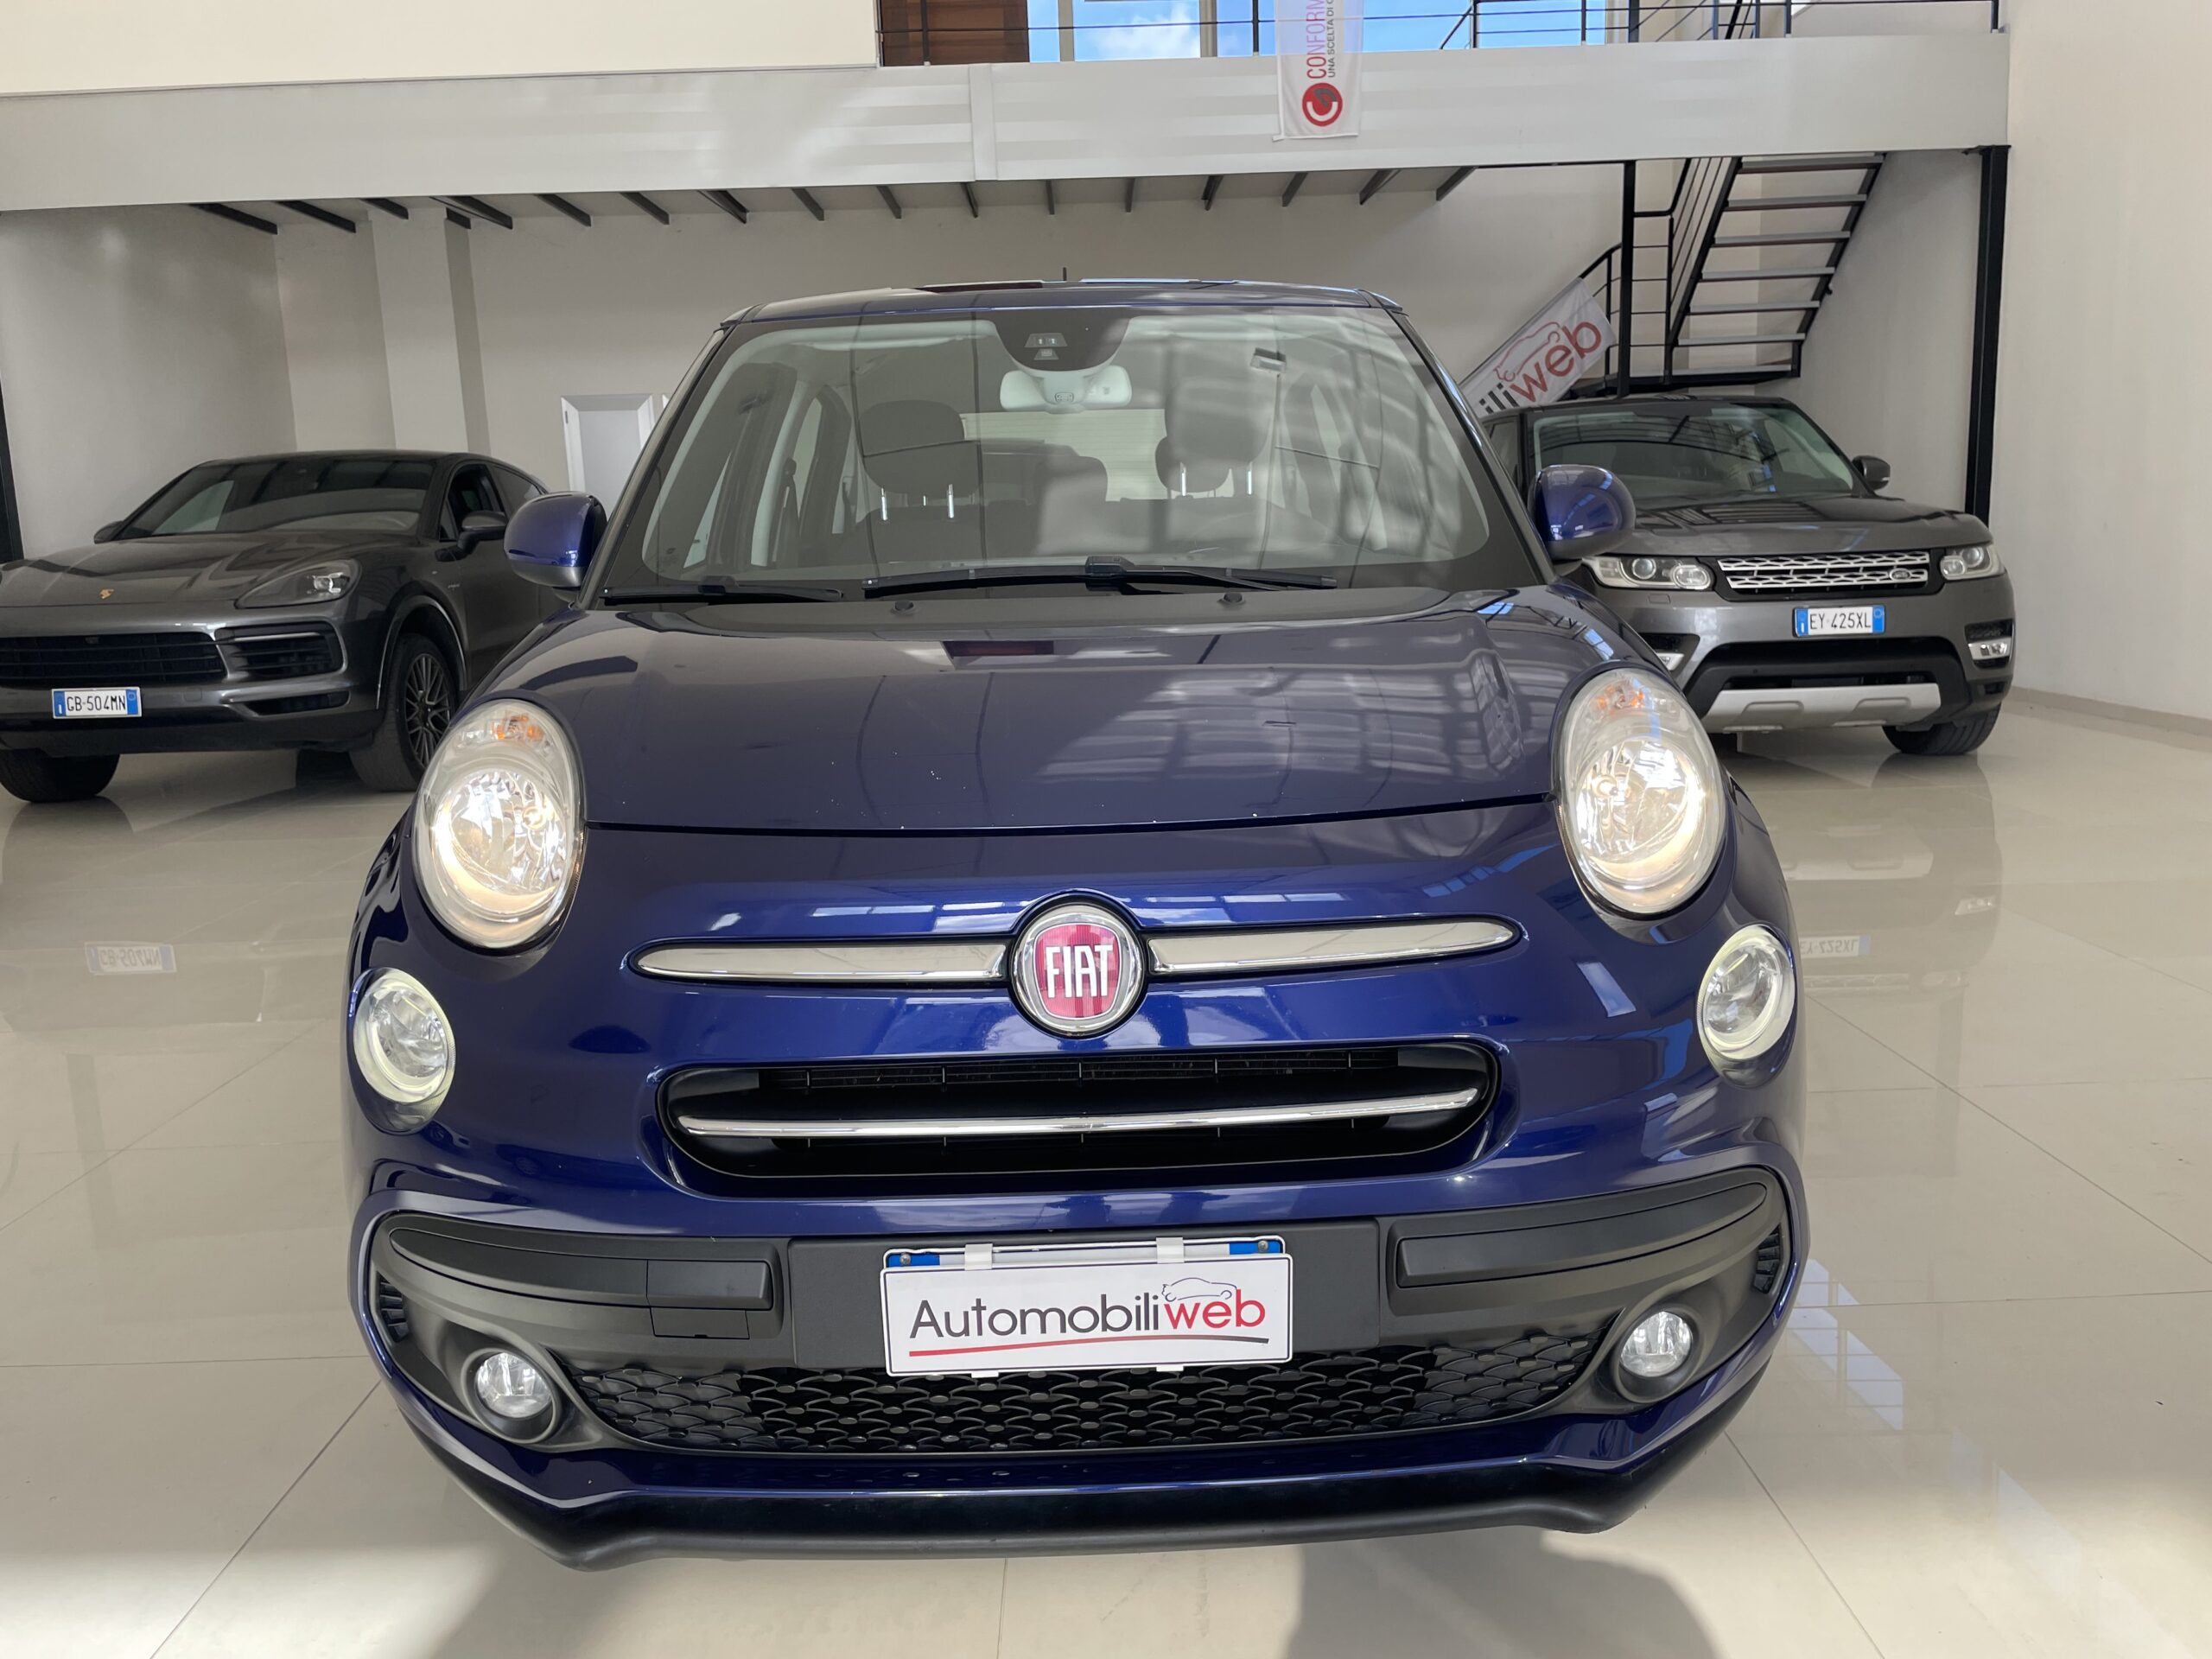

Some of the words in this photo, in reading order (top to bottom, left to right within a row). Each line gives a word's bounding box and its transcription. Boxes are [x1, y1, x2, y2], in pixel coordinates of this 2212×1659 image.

[1326, 7, 1334, 16] DI
[1326, 19, 1335, 54] SCELTA
[1327, 57, 1336, 78] UNA
[1046, 944, 1114, 998] FIAT
